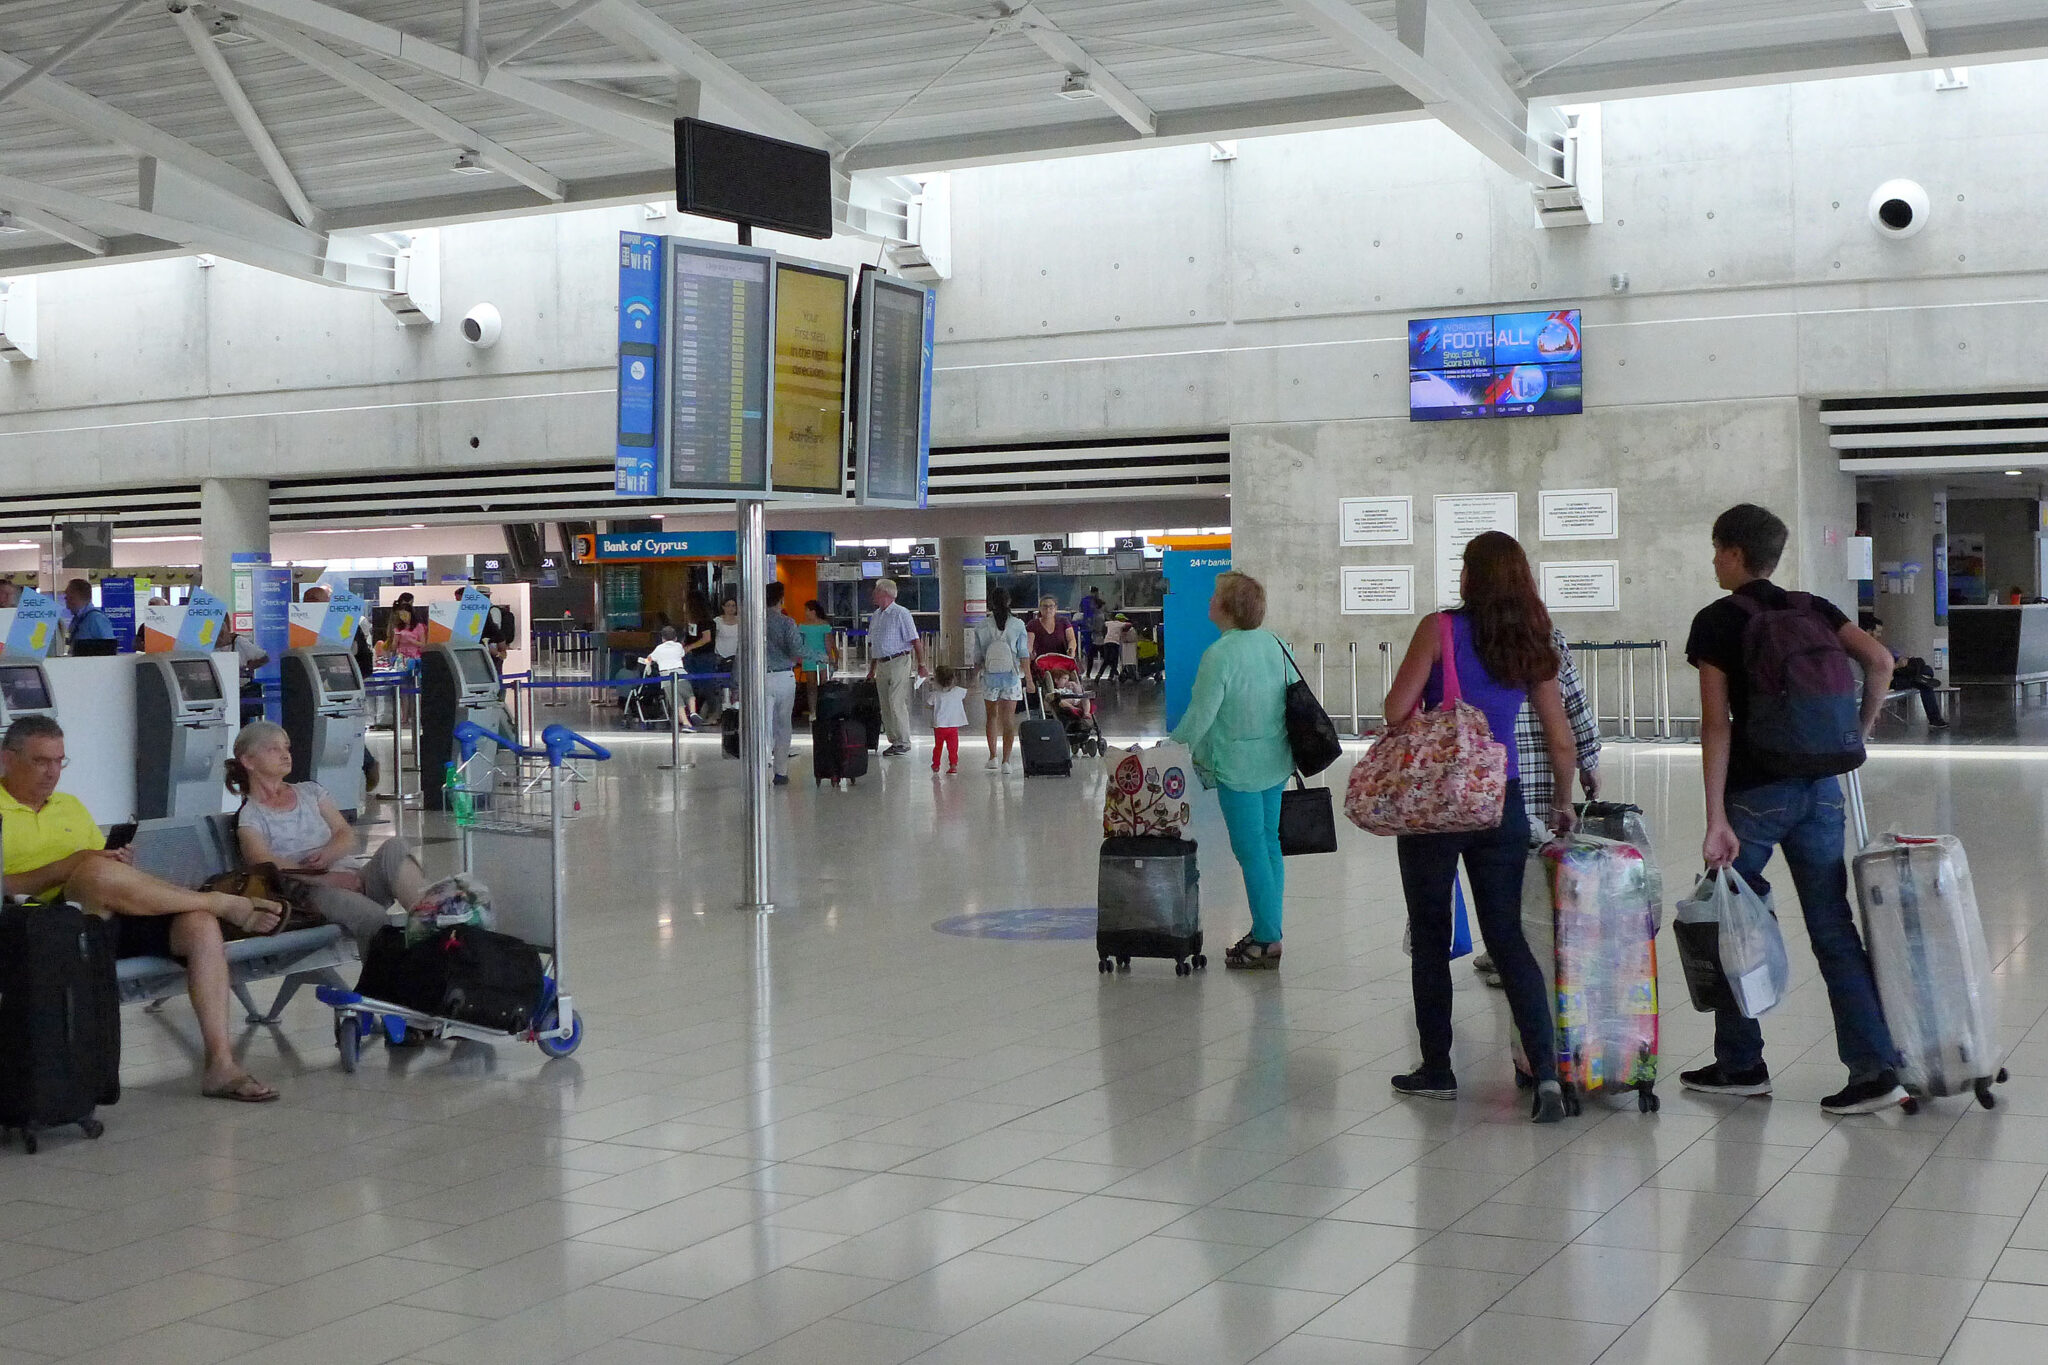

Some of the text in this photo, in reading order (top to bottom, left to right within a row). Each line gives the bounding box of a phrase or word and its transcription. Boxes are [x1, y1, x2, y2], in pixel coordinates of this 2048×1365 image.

[1442, 328, 1530, 350] FOOTBALL
[1443, 359, 1462, 368] Score
[1472, 357, 1487, 366] Win!
[603, 540, 688, 554] Bank of Cyprus
[989, 543, 1000, 552] 27
[1041, 541, 1053, 551] 26
[1122, 538, 1134, 548] 25
[867, 548, 877, 557] 29
[915, 546, 925, 555] 28
[541, 558, 554, 568] 2A
[1190, 559, 1201, 567] 24
[23, 599, 46, 607] SELF
[194, 598, 213, 606] SELF
[188, 608, 223, 616] CHECK-IN
[329, 605, 362, 613] CHECK-IN
[17, 609, 57, 619] CHECK-IN
